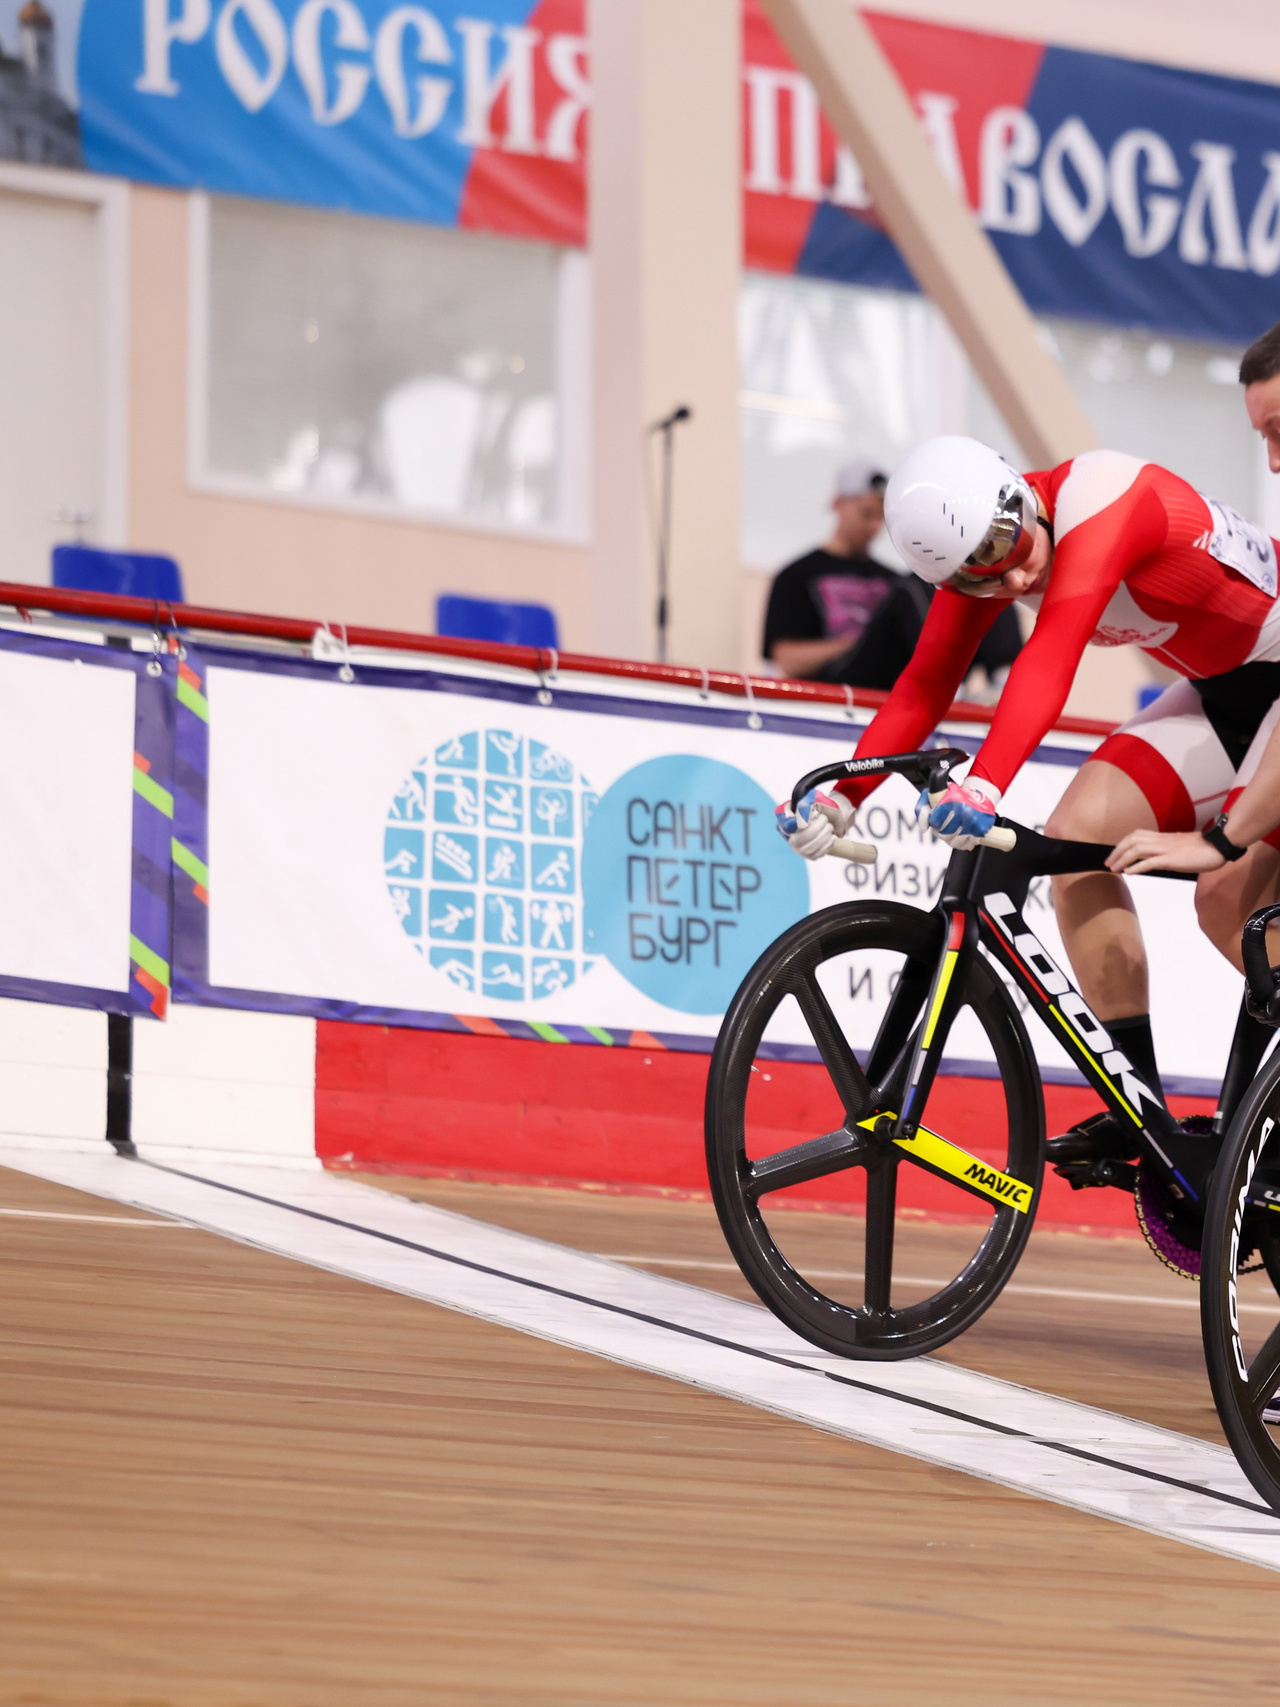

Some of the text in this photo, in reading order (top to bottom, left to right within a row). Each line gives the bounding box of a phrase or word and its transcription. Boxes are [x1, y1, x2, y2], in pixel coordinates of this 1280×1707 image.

[844, 757, 885, 773] Velobike
[626, 796, 758, 857] САНКТ
[627, 854, 763, 914] ПЕТЕР
[628, 911, 739, 968] БУРГ
[984, 892, 1164, 1117] LOOK
[963, 1163, 1028, 1204] MAVIC
